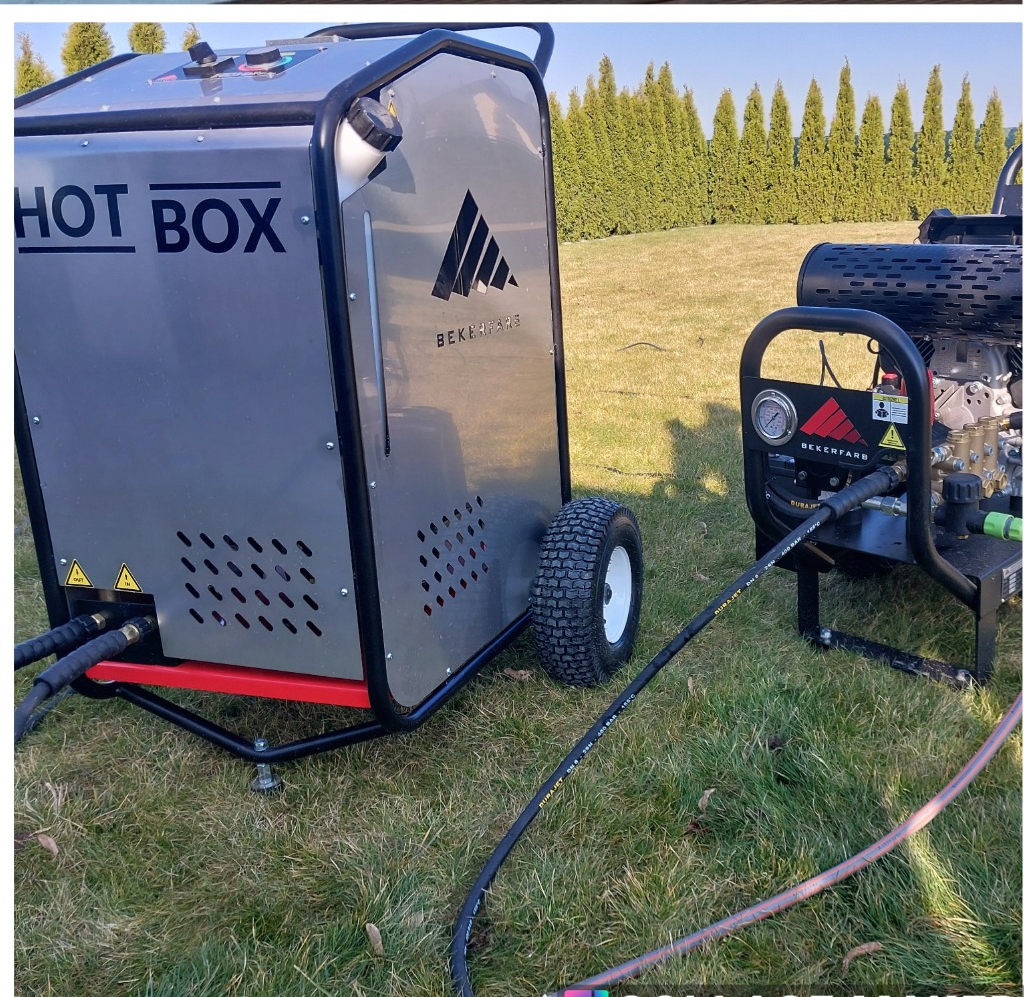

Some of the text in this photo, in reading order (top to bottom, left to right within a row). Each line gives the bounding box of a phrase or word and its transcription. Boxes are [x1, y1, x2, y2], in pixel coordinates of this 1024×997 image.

[14, 184, 287, 254] HOT BOX
[437, 313, 521, 348] BEKERFARB
[801, 442, 868, 461] BEKERFARB
